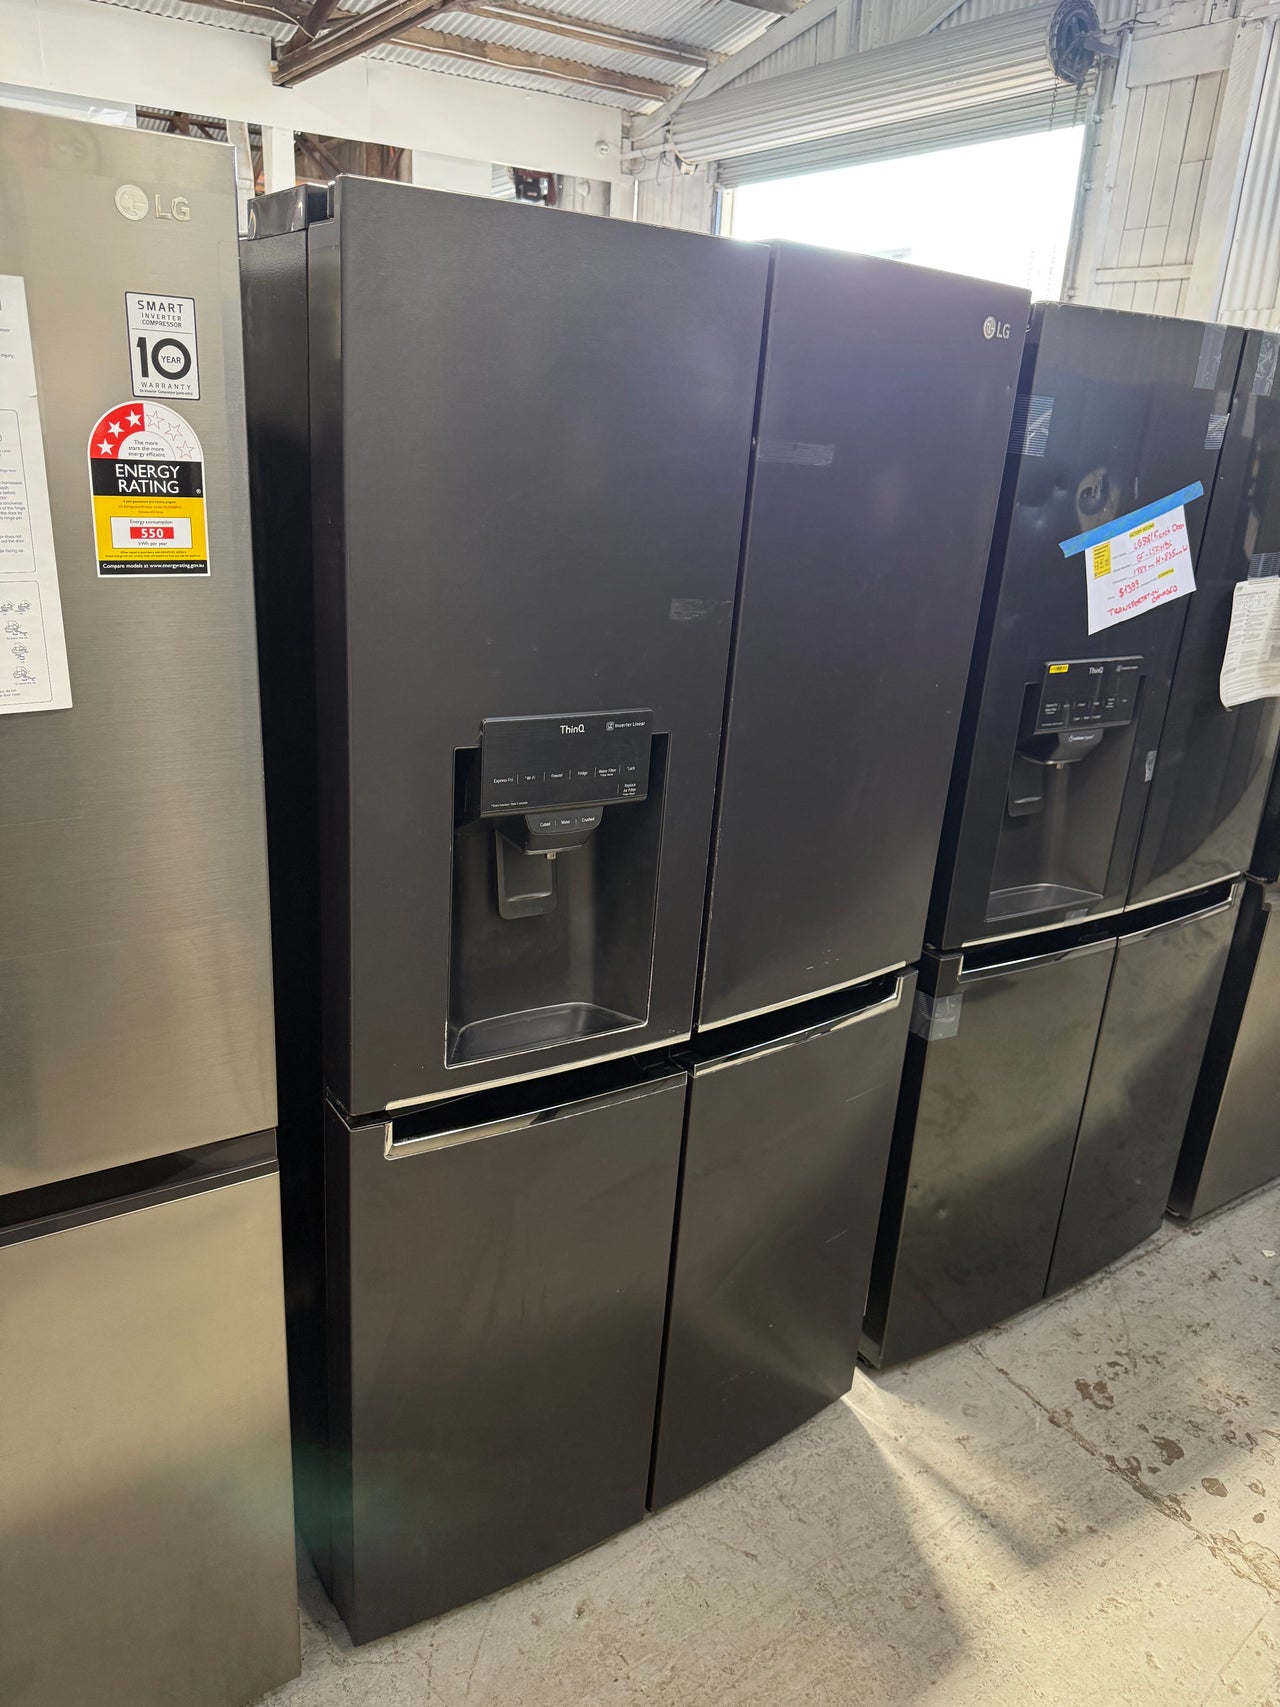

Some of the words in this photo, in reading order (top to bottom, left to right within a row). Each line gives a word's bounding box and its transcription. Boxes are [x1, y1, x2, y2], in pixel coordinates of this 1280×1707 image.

[154, 194, 190, 221] LG
[137, 300, 184, 314] SMART
[141, 312, 182, 321] INVERTER
[141, 319, 182, 328] COMPRESSOR
[996, 321, 1011, 339] LG
[136, 336, 192, 380] 10
[161, 355, 182, 364] YEAR
[141, 382, 191, 391] WARRANTY
[115, 463, 180, 479] ENERGY
[118, 479, 180, 494] RATING
[141, 528, 164, 539] 550
[559, 723, 585, 735] ThinQ
